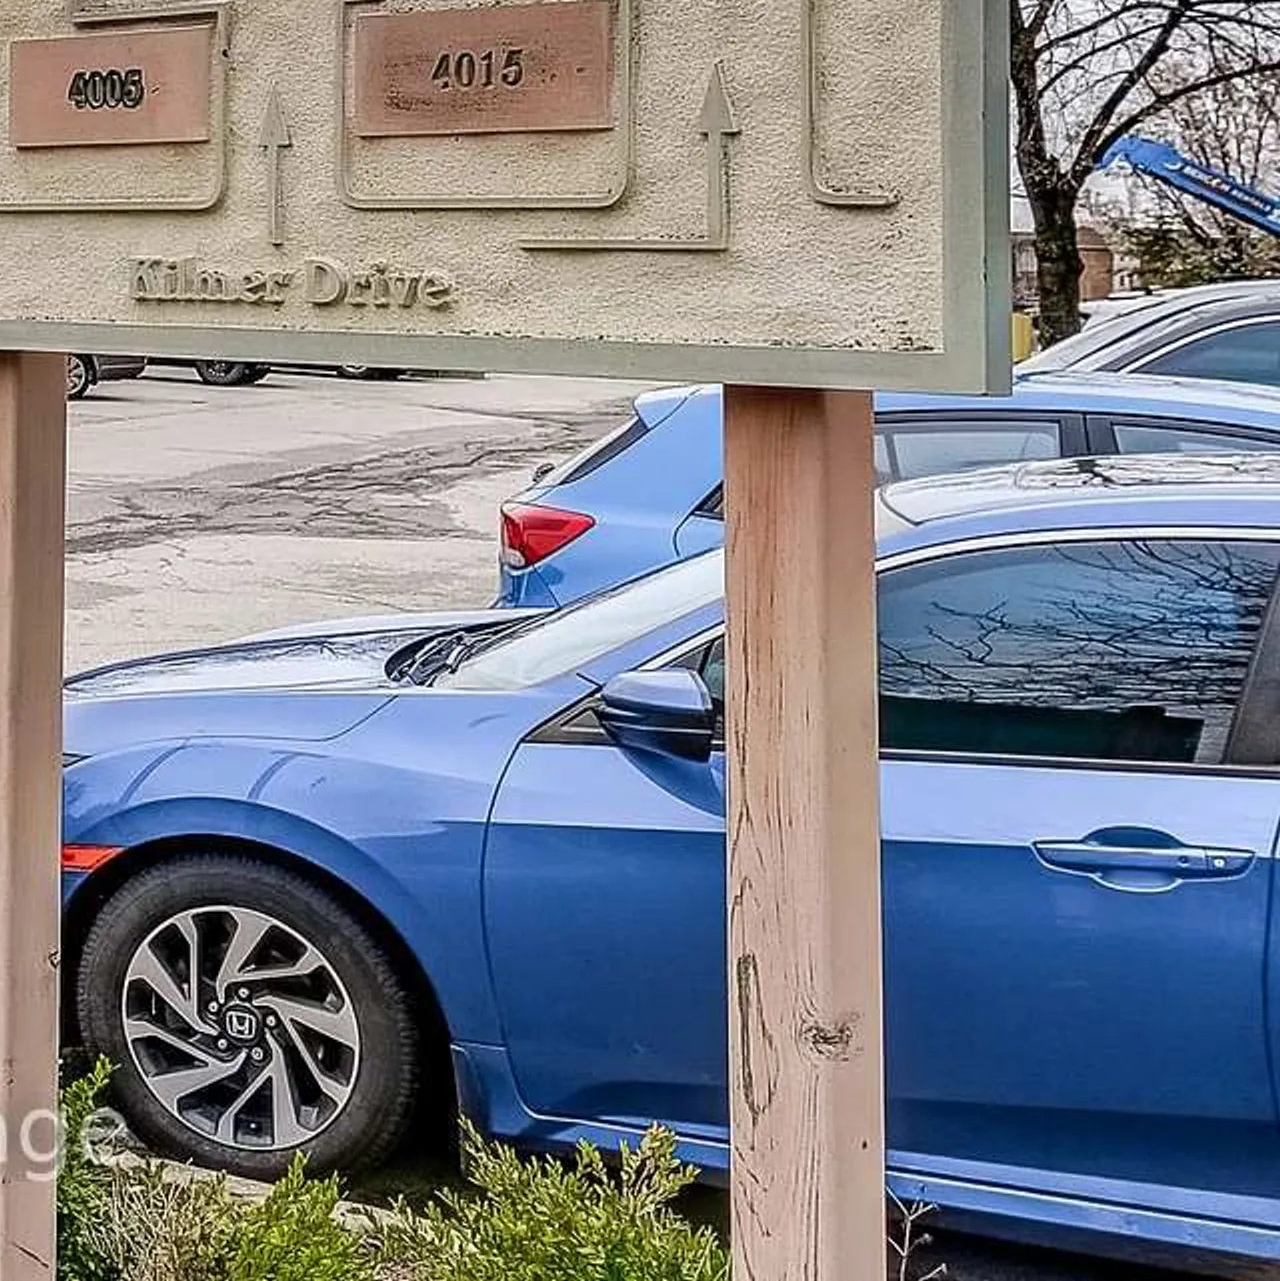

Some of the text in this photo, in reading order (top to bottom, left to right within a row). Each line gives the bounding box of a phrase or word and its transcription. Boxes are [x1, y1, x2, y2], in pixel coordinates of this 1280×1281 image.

[68, 69, 144, 110] 4005
[431, 47, 524, 90] 4015
[131, 257, 454, 309] Kilmer Drive
